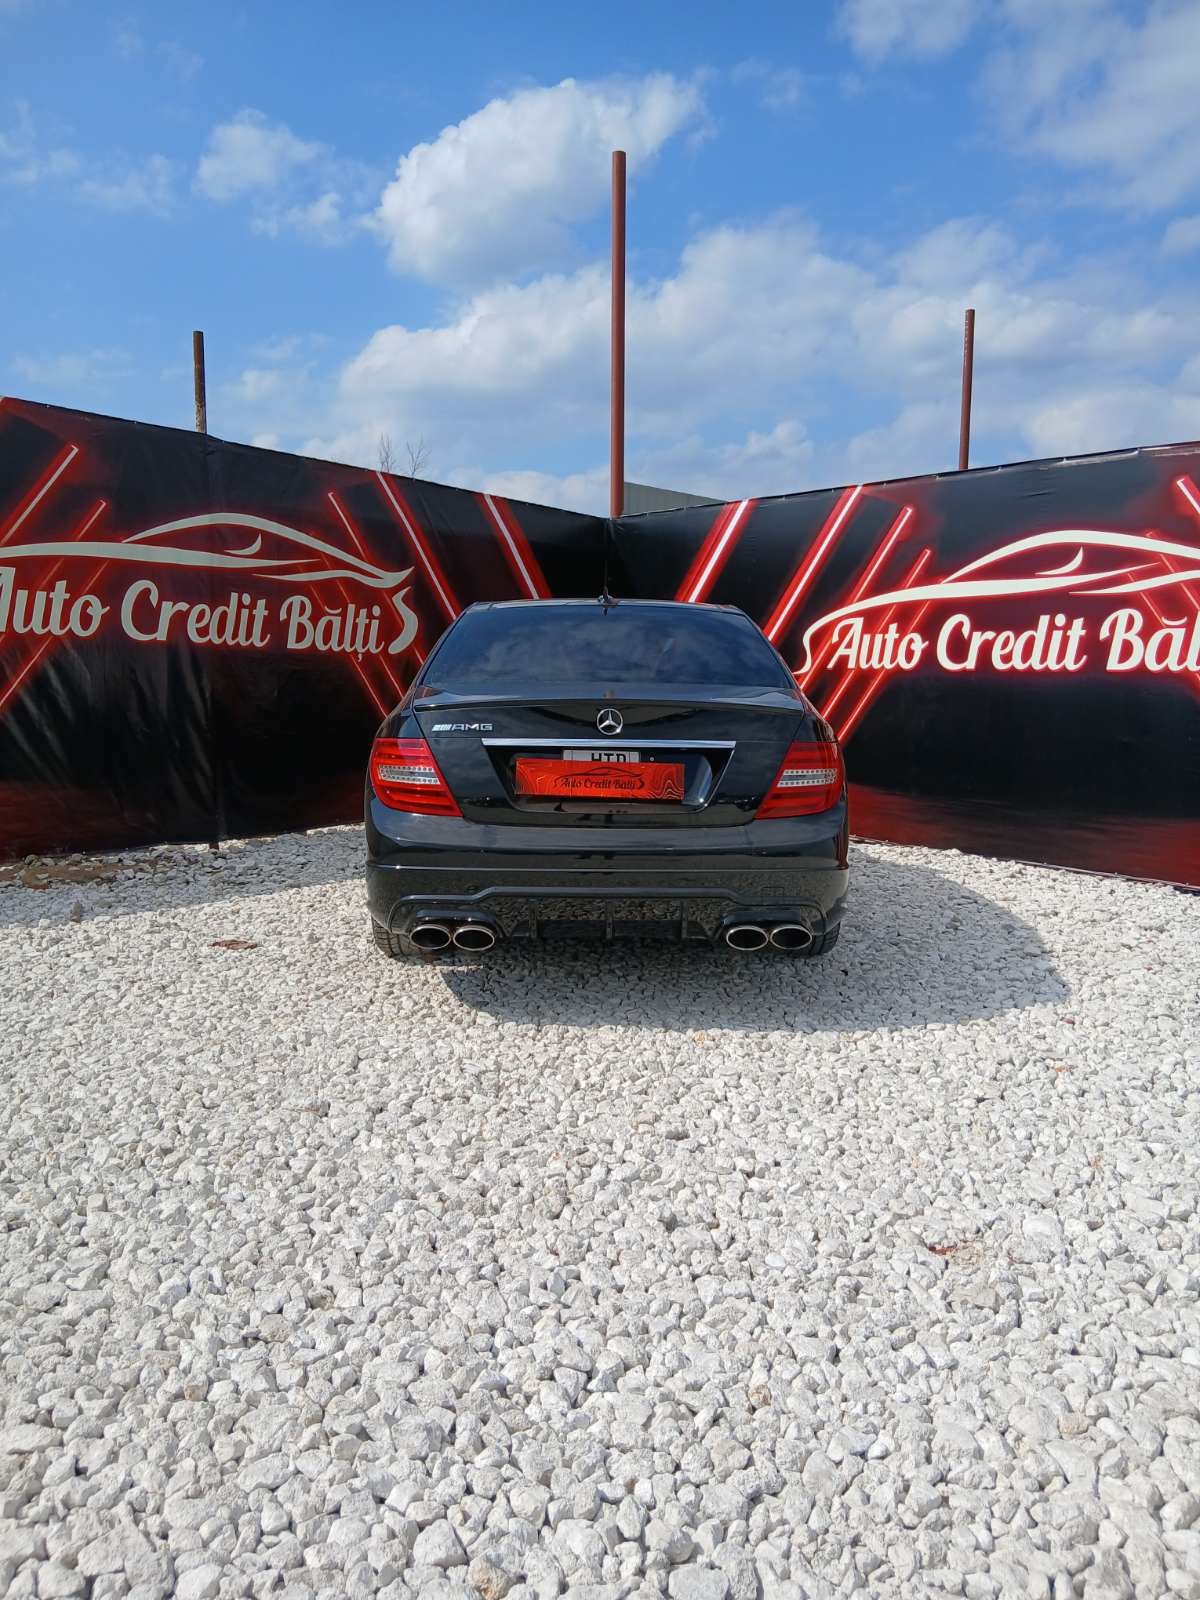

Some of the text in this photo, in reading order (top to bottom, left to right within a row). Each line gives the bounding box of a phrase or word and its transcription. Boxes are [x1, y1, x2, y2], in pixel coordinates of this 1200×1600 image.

[120, 579, 271, 648] Credit
[279, 595, 385, 662] Bălți
[827, 617, 929, 670] Auto
[936, 613, 1088, 671] Credit
[451, 723, 493, 731] AMG
